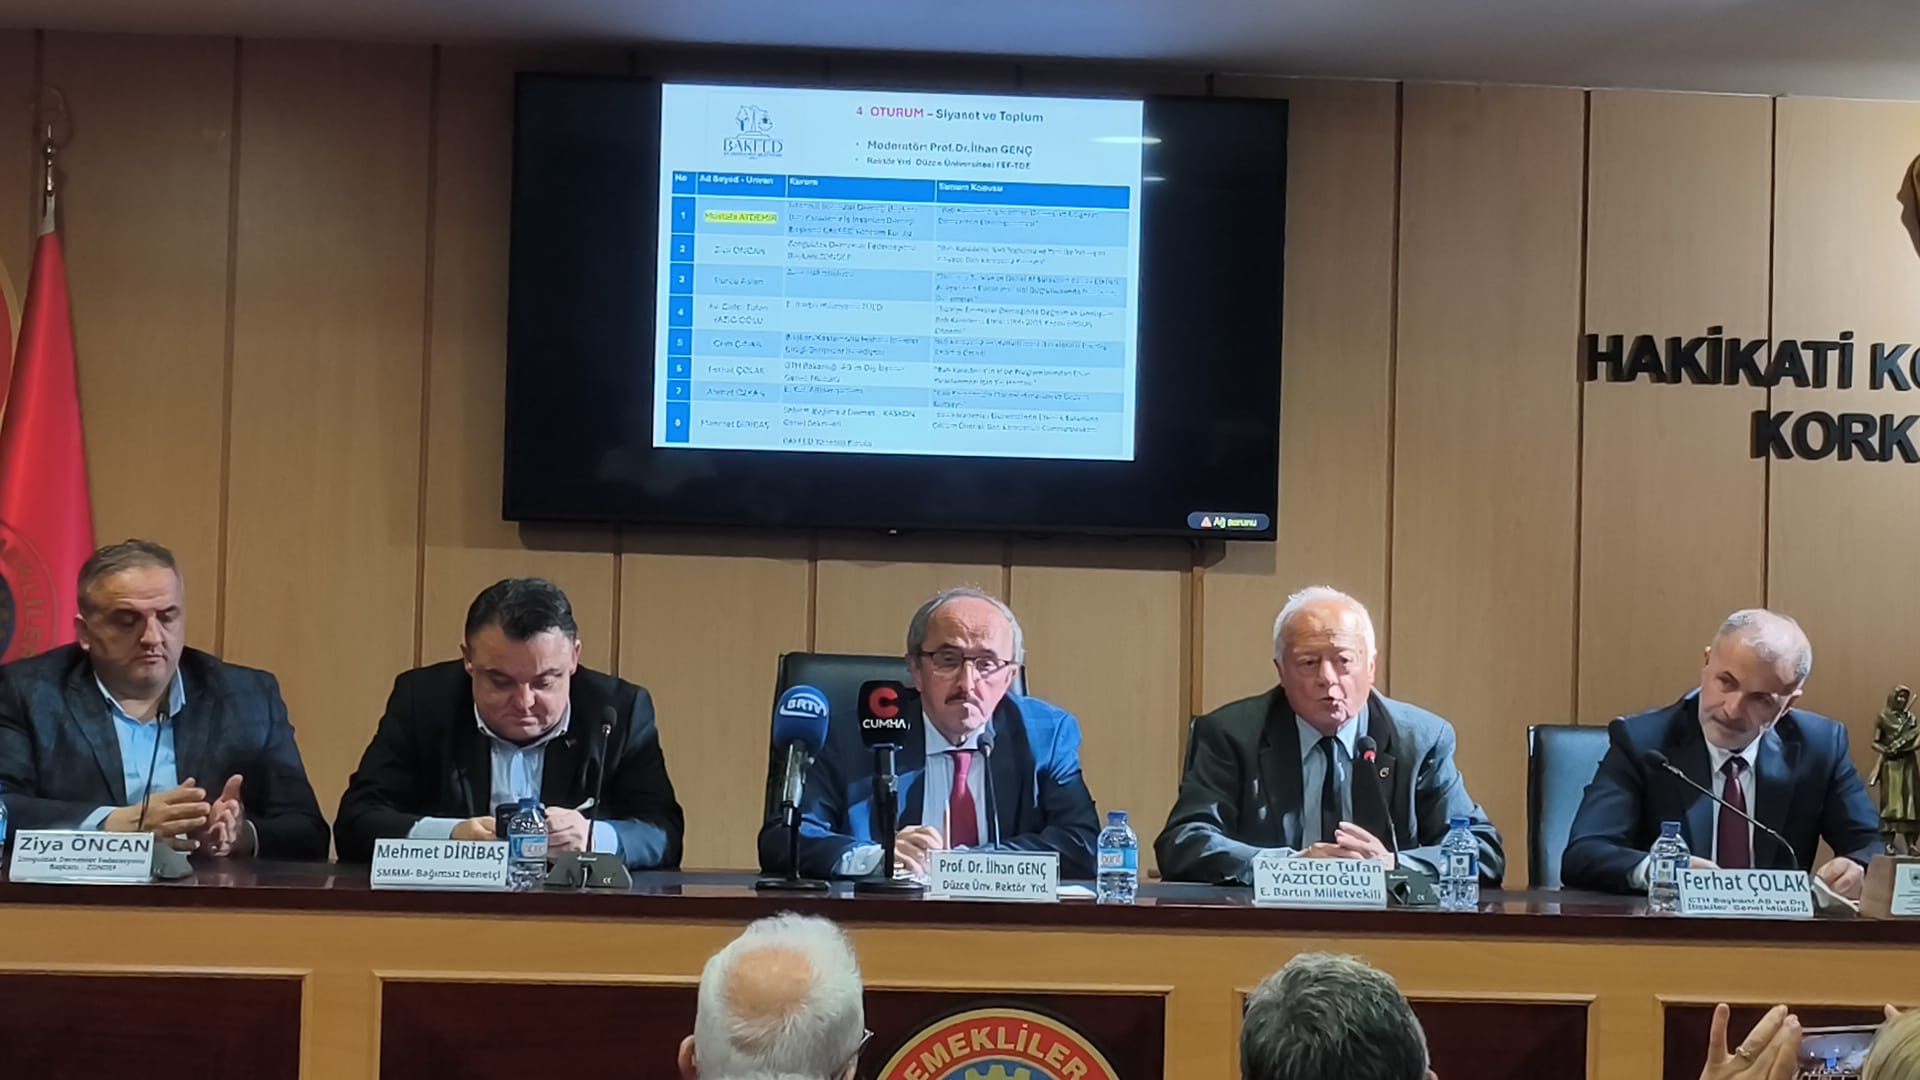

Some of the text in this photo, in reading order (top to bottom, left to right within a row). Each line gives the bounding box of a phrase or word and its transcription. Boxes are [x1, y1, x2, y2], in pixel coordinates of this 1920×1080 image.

[870, 107, 924, 118] OTURUM
[1000, 111, 1044, 123] Toplum
[1000, 144, 1033, 157] GENÇ
[1578, 325, 1855, 389] HAKİKATİ
[19, 834, 149, 855] Ziya ÖNCAN
[376, 843, 440, 860] Mehmet
[443, 841, 505, 865] DİRİBAŞ
[939, 856, 1047, 880] Prof. Dr. İlhan GENÇ
[1258, 859, 1382, 873] Av. Cafer Tufan
[942, 879, 971, 891] Düzce
[994, 881, 1026, 892] Rektör
[1271, 872, 1372, 887] YAZICIOĞLU
[1683, 871, 1809, 898] Ferhat ÇOLAK
[903, 1022, 1088, 1080] EMEKLİLER
